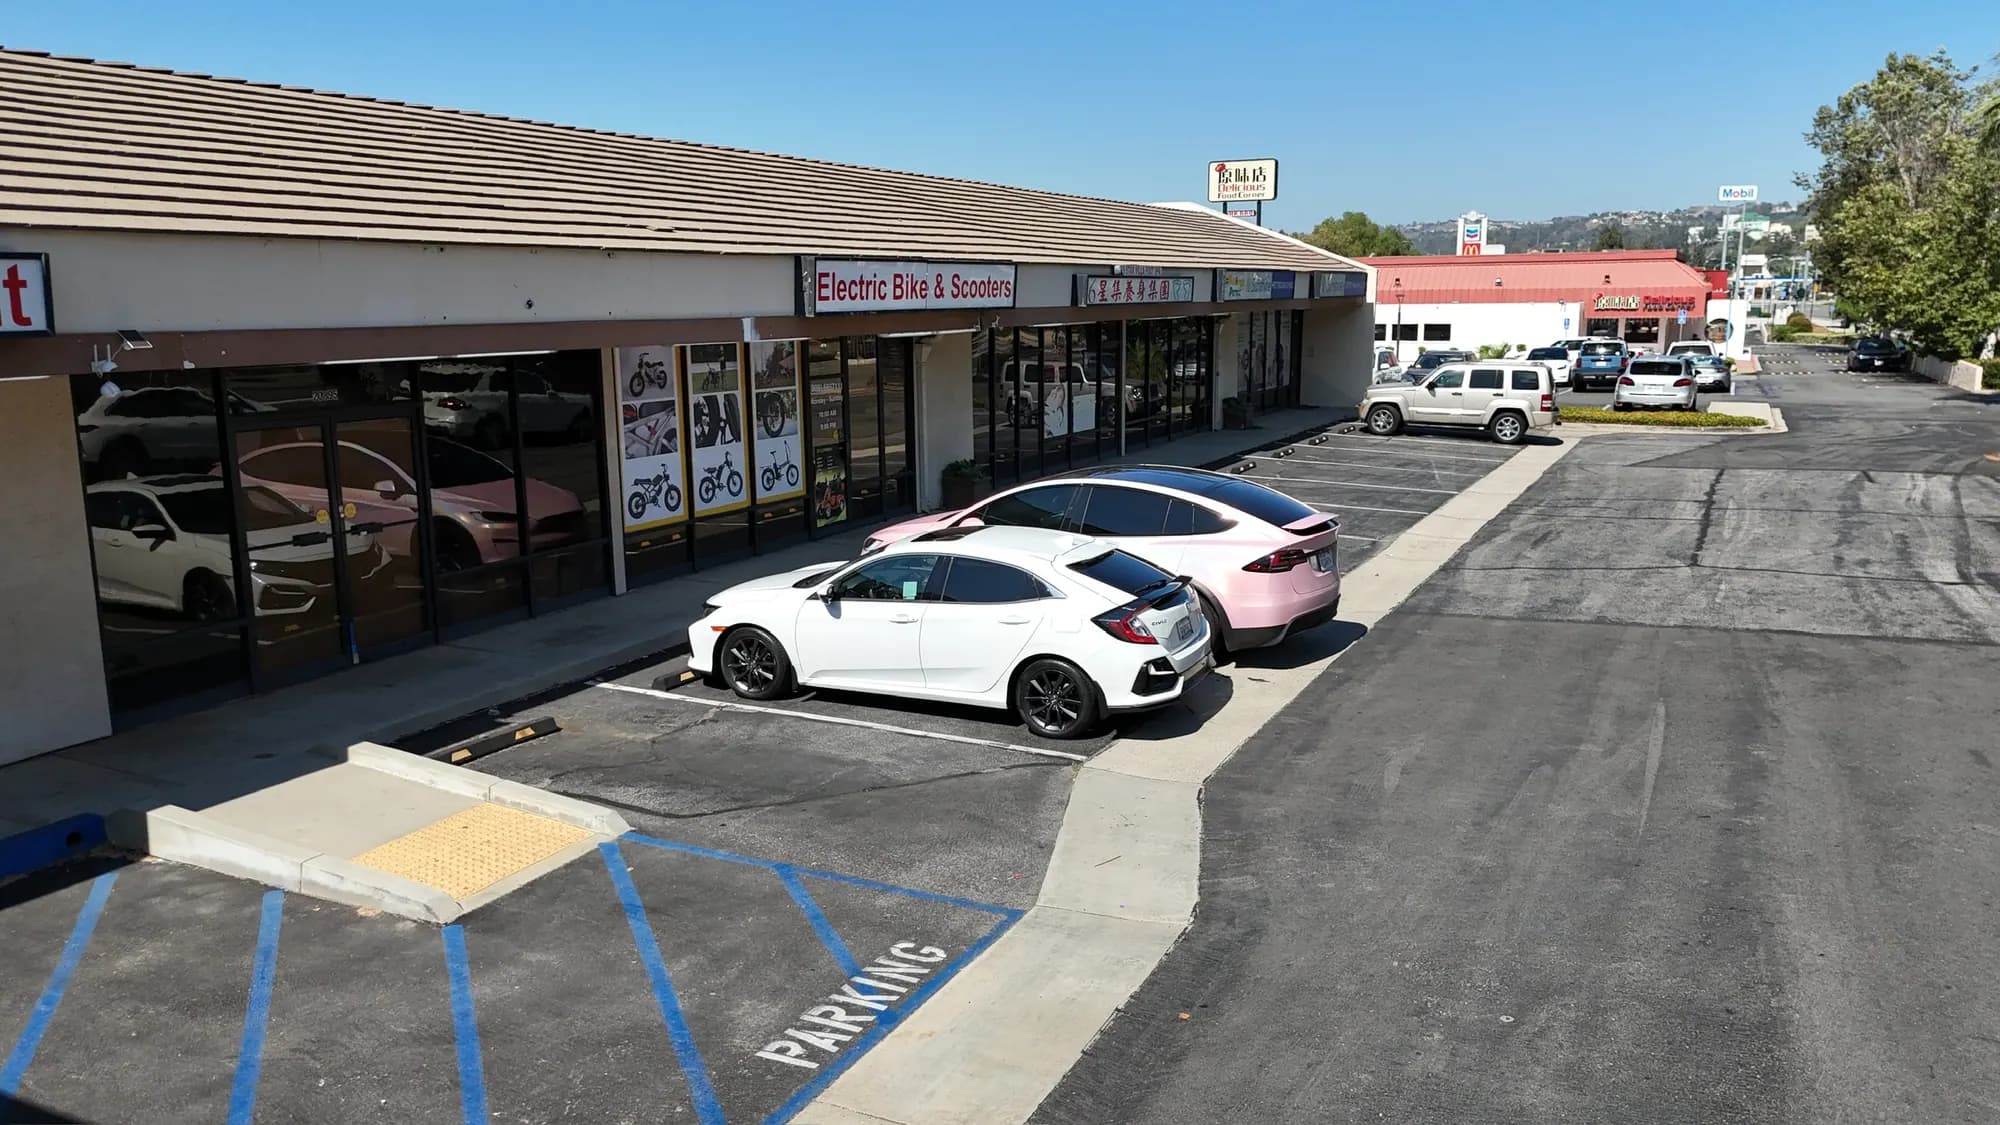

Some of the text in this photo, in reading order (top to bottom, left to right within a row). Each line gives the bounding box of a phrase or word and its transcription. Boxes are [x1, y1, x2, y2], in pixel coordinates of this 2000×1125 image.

[1218, 184, 1265, 192] Delicious
[1722, 188, 1754, 198] Mobil
[817, 271, 1012, 302] Electric Bike & Scooters
[754, 942, 947, 1069] PARKING
